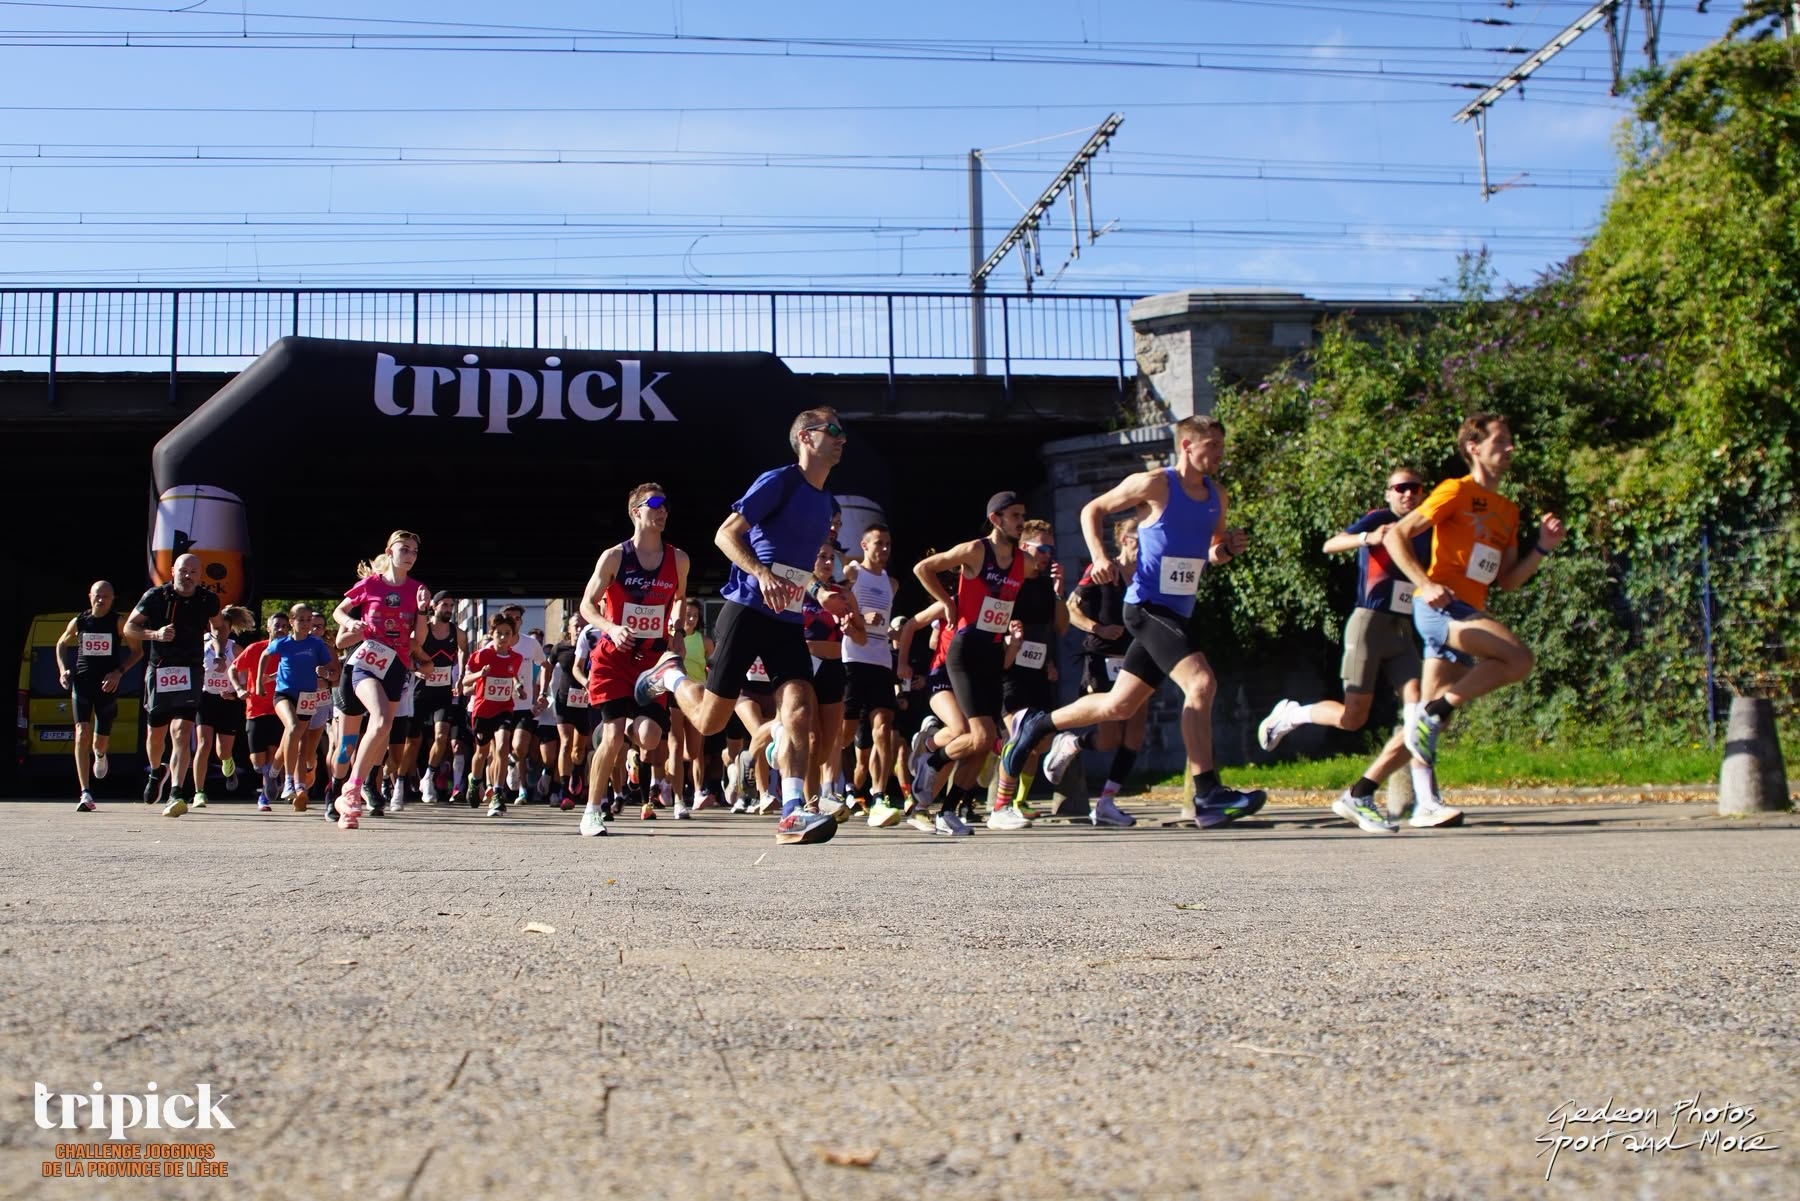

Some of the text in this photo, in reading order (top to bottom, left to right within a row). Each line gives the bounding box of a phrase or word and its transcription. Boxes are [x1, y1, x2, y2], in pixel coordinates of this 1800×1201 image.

[374, 352, 679, 434] tripick
[624, 577, 644, 586] RFC
[626, 615, 661, 631] 988
[983, 609, 1010, 626] 962
[85, 641, 110, 651] 959
[356, 649, 388, 671] 964
[1022, 649, 1043, 661] 4627
[160, 675, 188, 687] 984
[207, 679, 228, 687] 965
[429, 674, 449, 682] 971
[488, 685, 511, 696] 976
